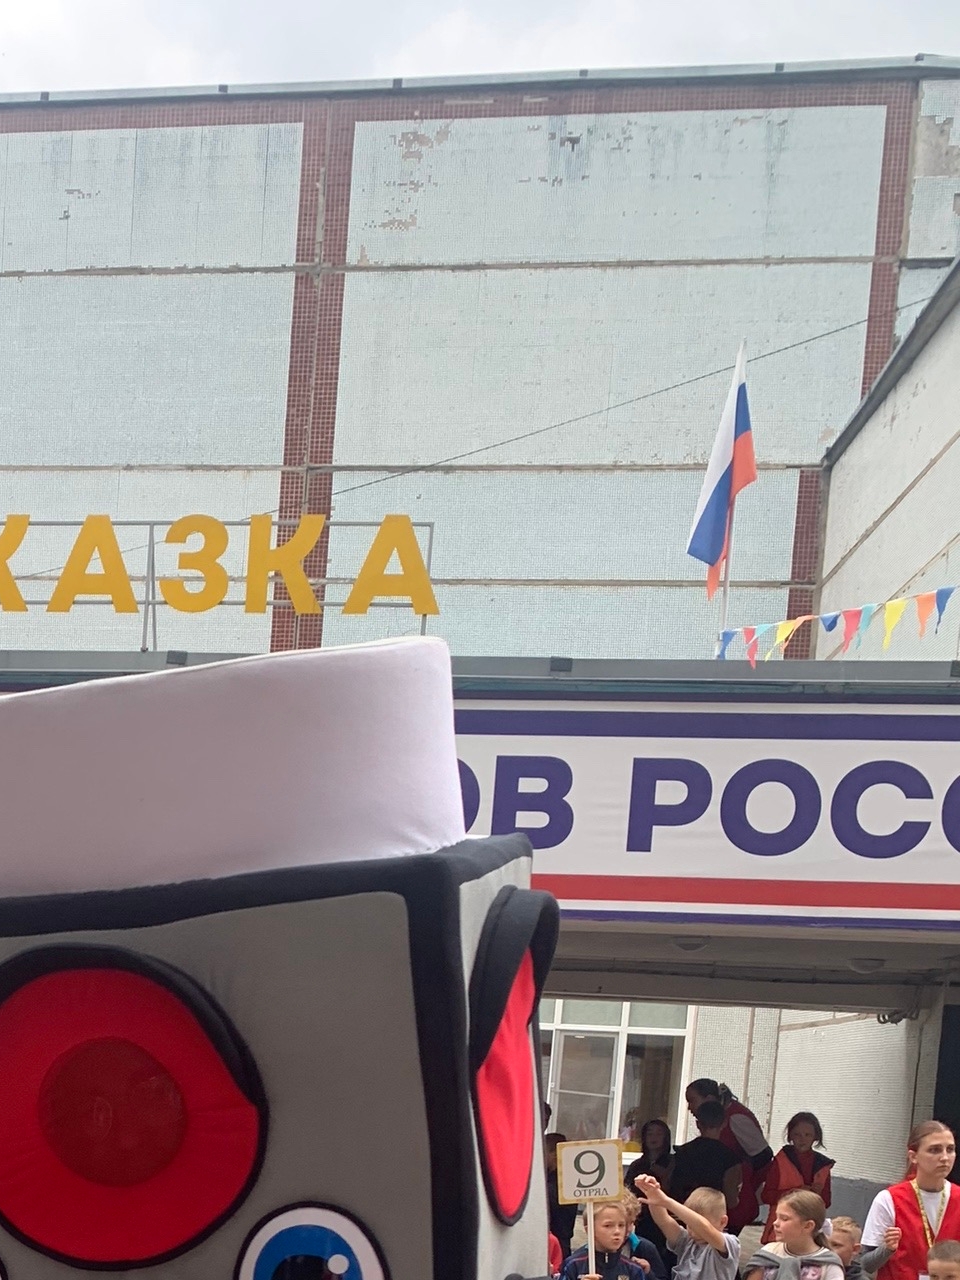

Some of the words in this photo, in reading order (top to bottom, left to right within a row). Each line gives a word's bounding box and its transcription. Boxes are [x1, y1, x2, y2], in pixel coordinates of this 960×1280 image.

[626, 757, 960, 859] РОС
[573, 1150, 606, 1188] 9
[573, 1187, 609, 1198] ОТРЯД
